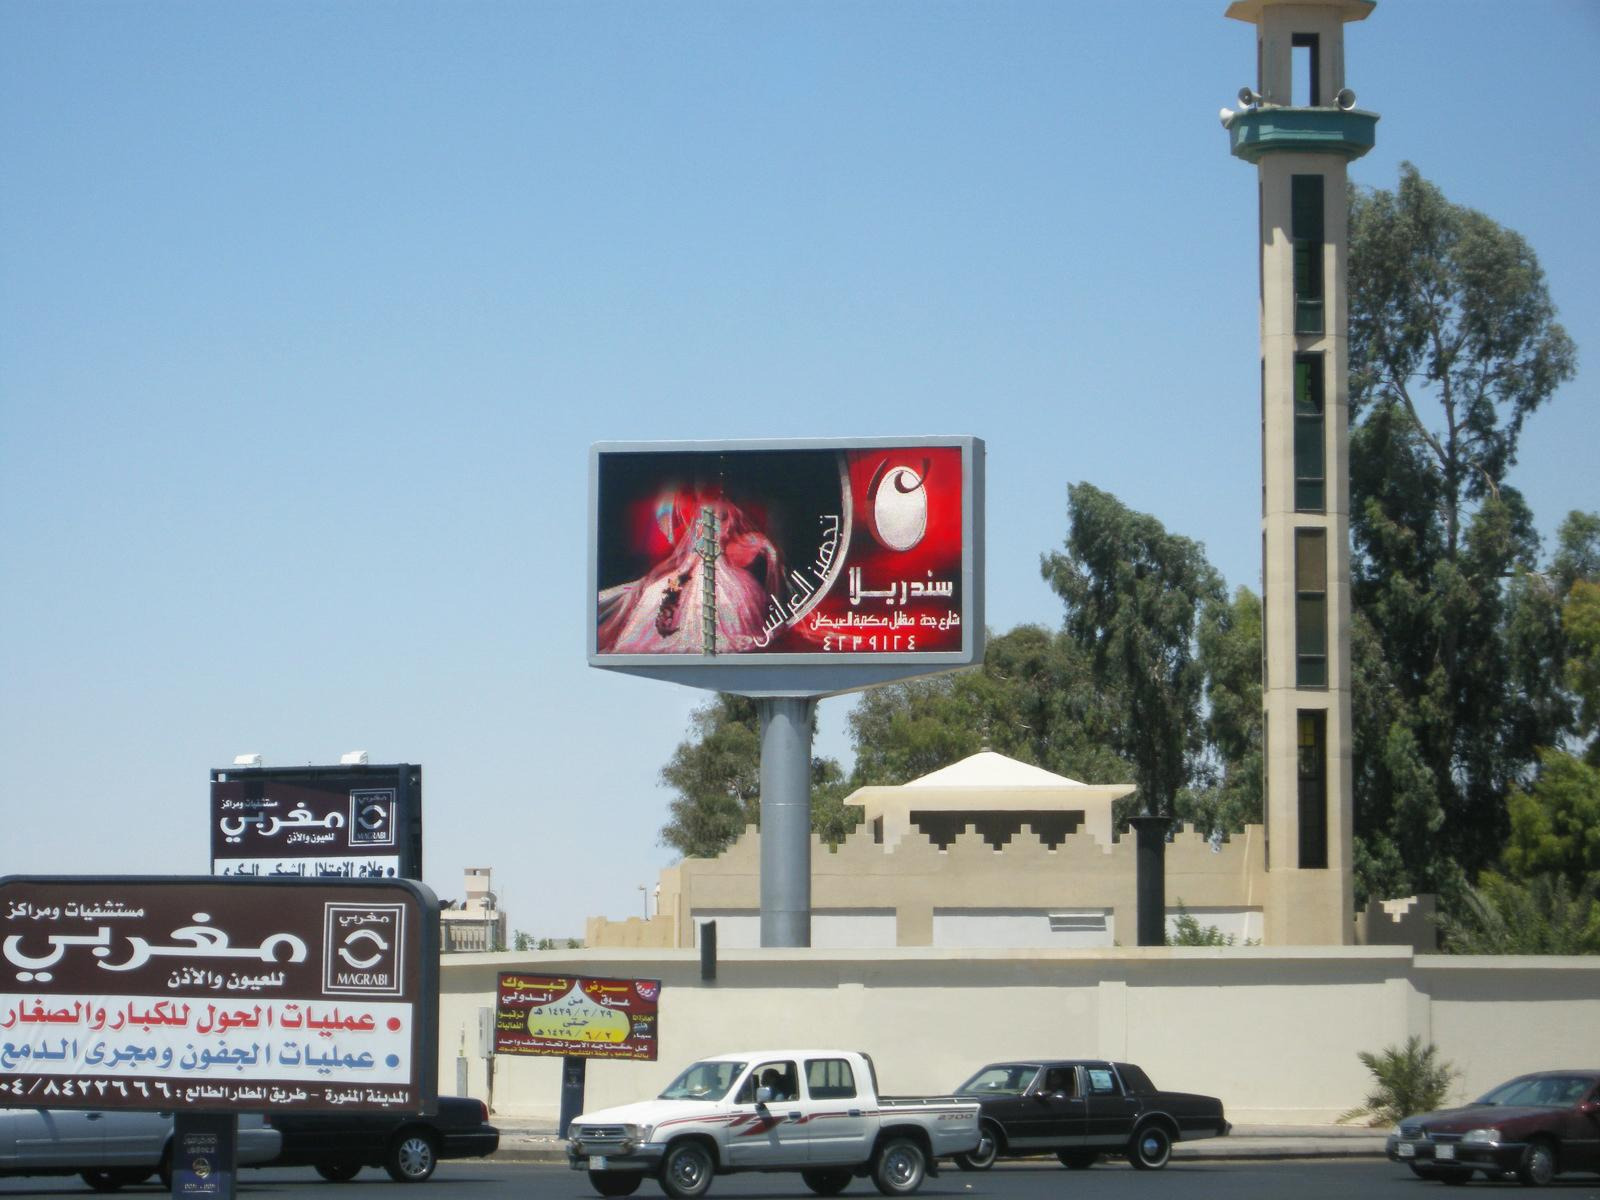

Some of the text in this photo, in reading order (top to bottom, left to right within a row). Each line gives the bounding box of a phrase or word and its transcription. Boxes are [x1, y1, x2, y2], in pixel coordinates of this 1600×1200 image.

[848, 566, 954, 605] سندريلا
[853, 613, 889, 630] مكتبة
[889, 611, 916, 630] مقابل
[919, 612, 936, 629] جدة
[938, 610, 961, 630] شارع
[220, 800, 244, 809] ومراكز
[219, 802, 345, 843] مغربي
[311, 833, 335, 844] للعيون
[5, 900, 145, 921] مستشفيات ومراكز
[338, 912, 390, 927] مغربي
[2, 912, 307, 982] مغربي
[226, 971, 286, 990] للعيون
[336, 973, 388, 986] MAGRABI
[501, 991, 552, 1004] الدولي
[568, 996, 584, 1006] من
[0, 998, 377, 1038] عمليات الحول للكبار والصغار
[0, 1037, 375, 1075] عمليات الجفون ومجرى الدمع
[185, 1085, 229, 1102] الطالع
[230, 1085, 267, 1102] المطار
[269, 1086, 307, 1104] طريق
[324, 1088, 363, 1105] المنورة
[366, 1088, 409, 1107] المدينة
